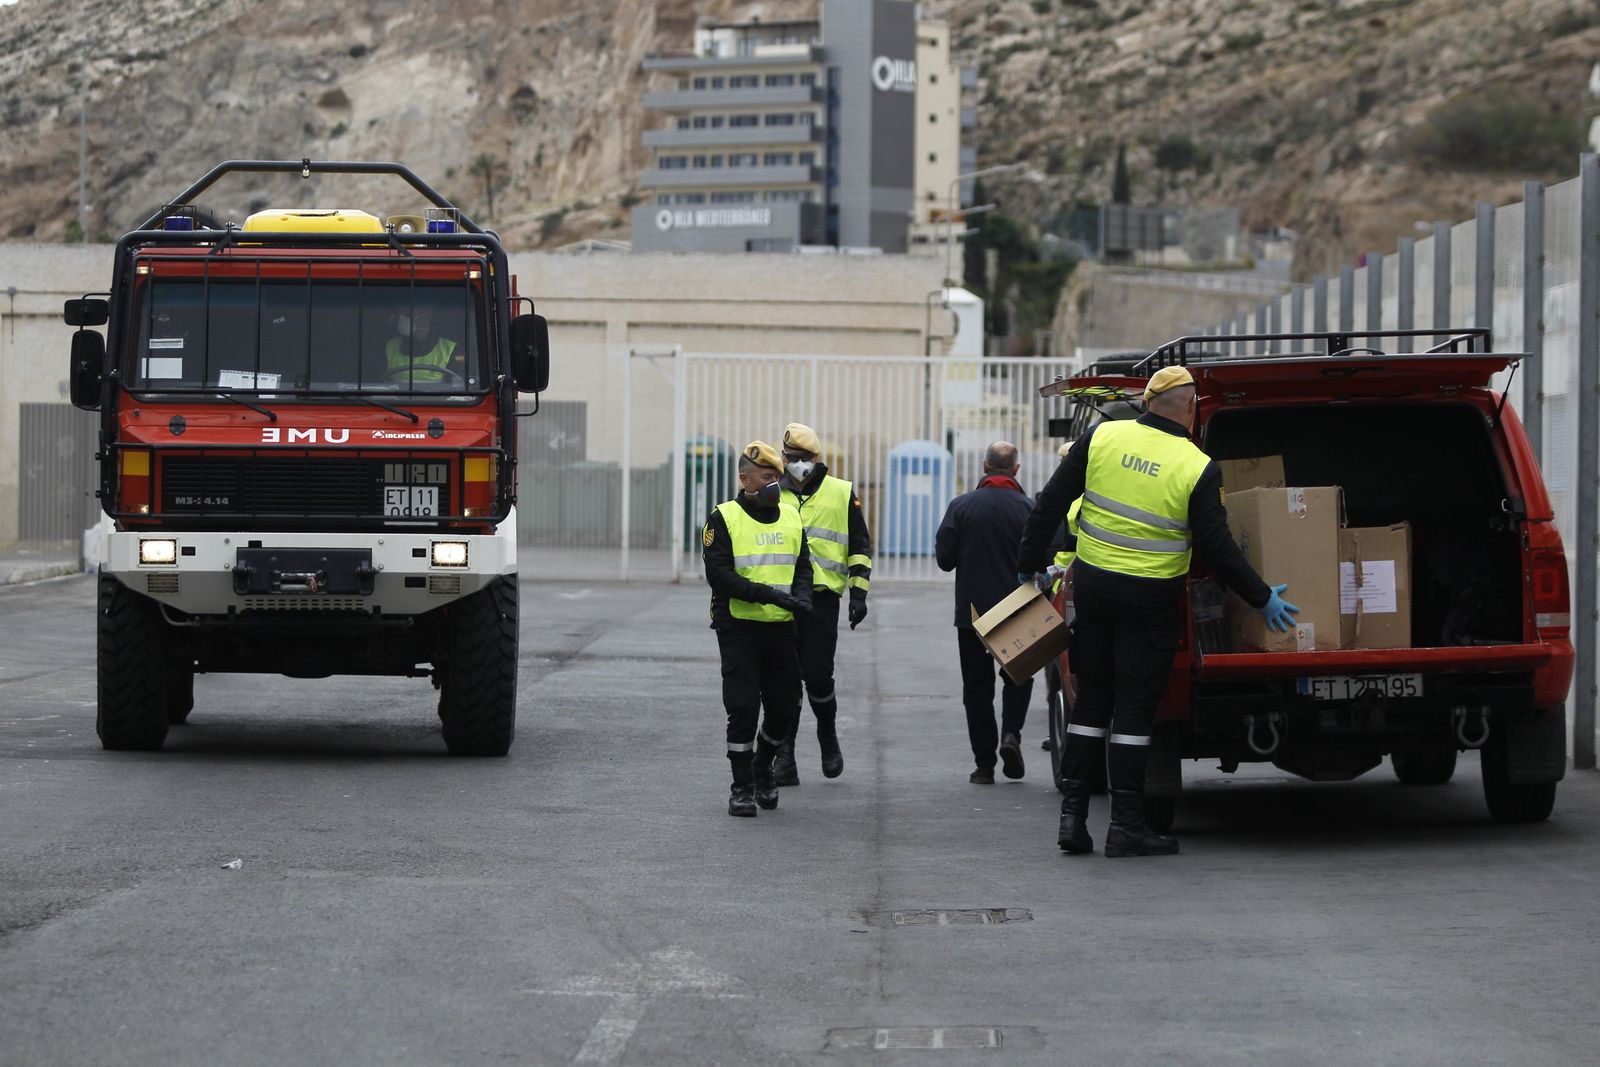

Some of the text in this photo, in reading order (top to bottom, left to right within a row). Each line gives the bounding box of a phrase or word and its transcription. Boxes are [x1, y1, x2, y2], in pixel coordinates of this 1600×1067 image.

[385, 463, 448, 484] URO
[1121, 453, 1161, 477] UME
[386, 489, 434, 505] ET 11
[755, 532, 784, 546] UME
[1312, 679, 1336, 700] ET
